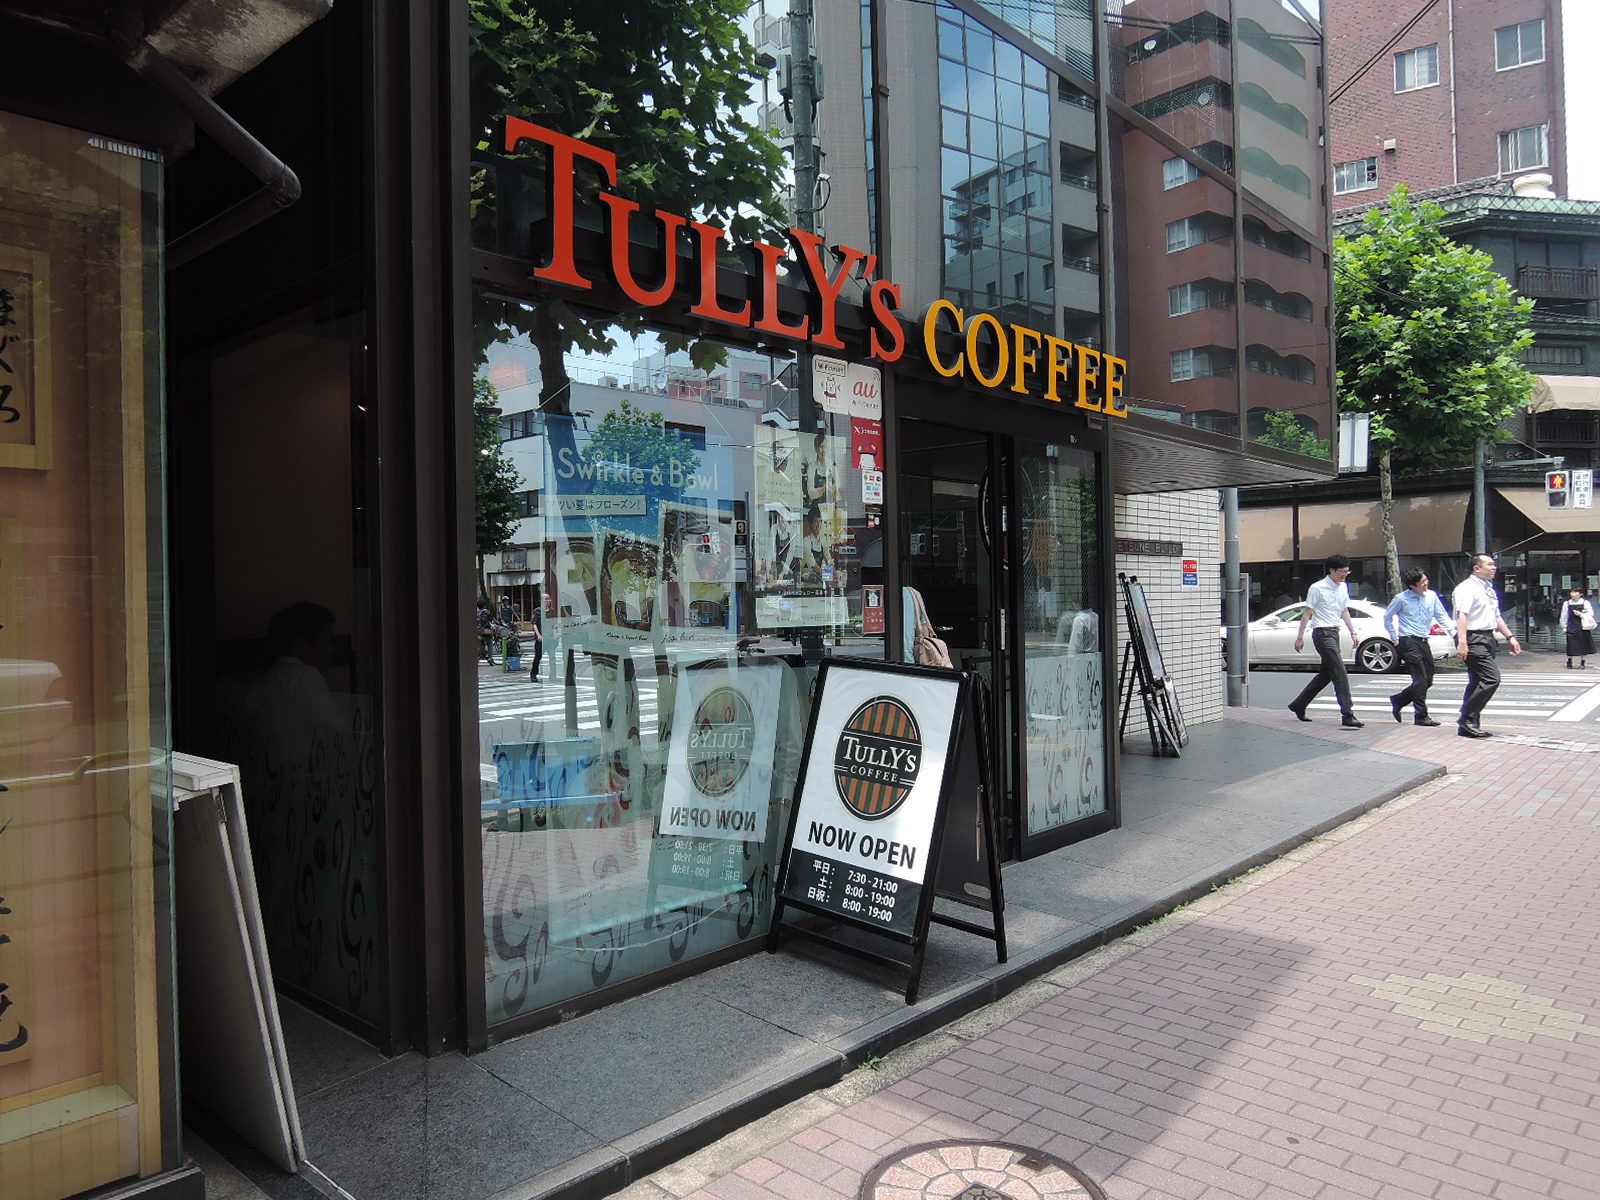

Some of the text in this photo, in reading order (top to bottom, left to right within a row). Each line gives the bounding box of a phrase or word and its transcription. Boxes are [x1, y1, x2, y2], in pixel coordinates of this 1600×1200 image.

[505, 115, 1128, 419] TULLY'S COFFEE
[853, 381, 879, 399] au
[557, 447, 719, 491] Swirkle & Bowl
[554, 499, 640, 511] ツい夏はフローズン!
[842, 734, 918, 773] TULLY'S
[850, 764, 899, 783] COFFEE
[808, 821, 917, 870] NOW OPEN
[848, 870, 867, 884] 7:30
[872, 878, 898, 893] 21:00
[845, 884, 864, 898] 8:00
[869, 892, 896, 907] 19:00
[842, 898, 861, 912] 8:00
[867, 907, 893, 922] 19:00
